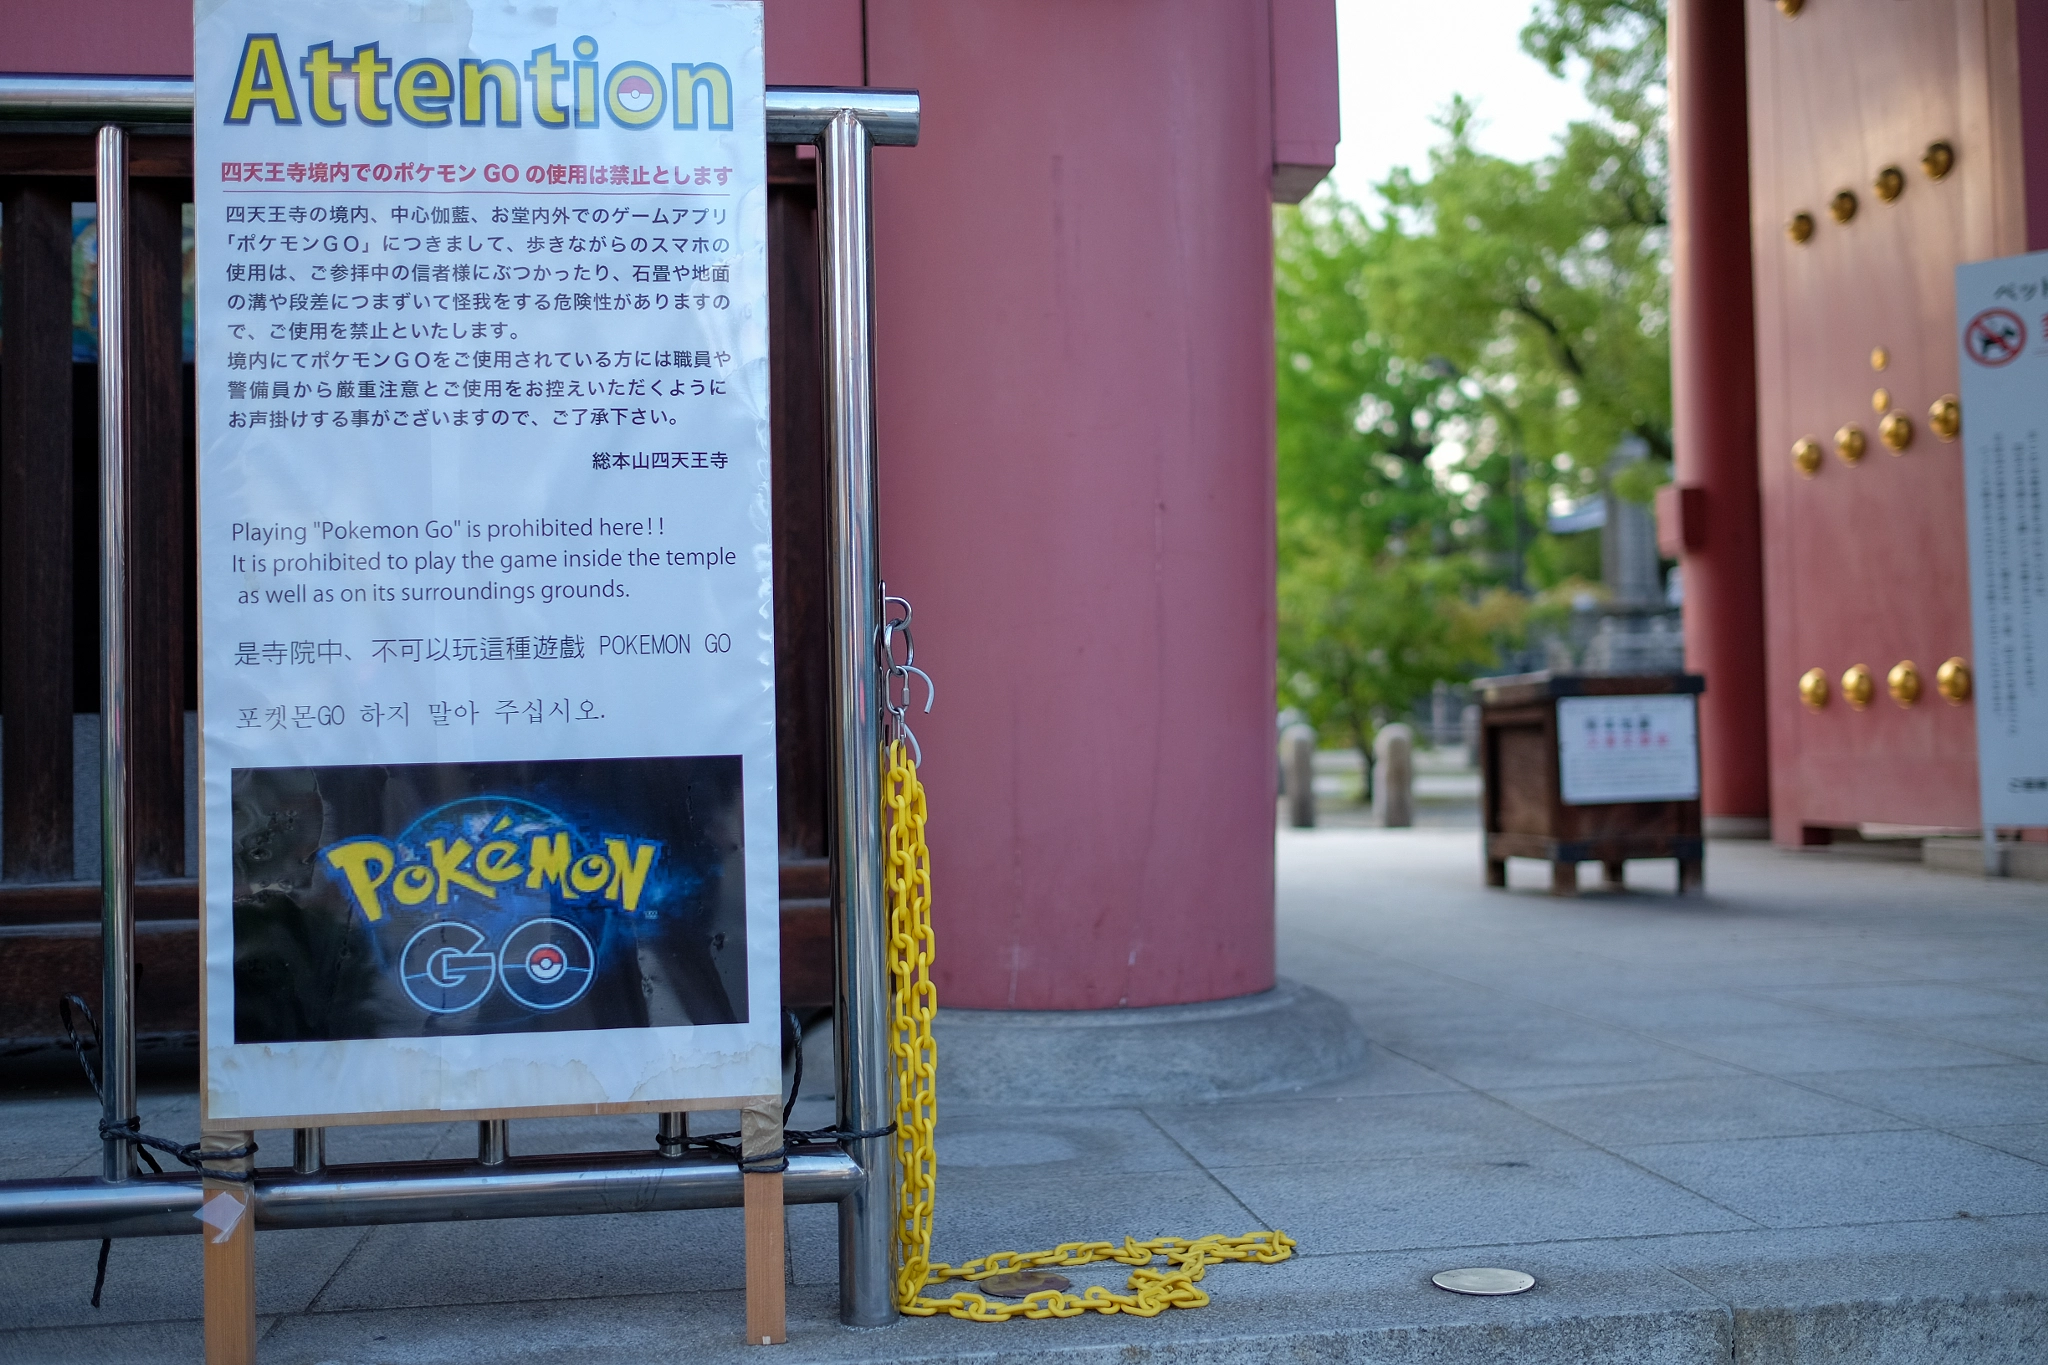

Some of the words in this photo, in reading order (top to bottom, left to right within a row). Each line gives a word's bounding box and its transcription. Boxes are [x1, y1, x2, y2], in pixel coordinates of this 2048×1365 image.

[223, 32, 734, 131] Attention
[221, 161, 477, 183] 四天王寺境内でのポケモン
[483, 164, 520, 184] GO
[525, 164, 733, 186] の使用は禁止とします
[226, 205, 727, 225] 四天王寺の境内、中心伽藍、お堂内外でのゲームアプリ
[226, 263, 730, 283] 使用は、ご参拝中の信者様にぶつかったり、石畳や地面
[227, 292, 731, 312] の溝や段差につまずいて怪我をする危険性がありますの
[227, 321, 518, 341] で、ご使用を禁止といたします。
[227, 379, 727, 400] 警備員から厳重注意とご使用をお控えいただくように
[228, 407, 677, 429] お声掛けする事がございますので、ご了承下さい。
[592, 451, 729, 470] 総本山四天王寺
[232, 522, 307, 546] Playing
[313, 520, 419, 540] "Pokemon
[425, 520, 461, 539] Go"
[466, 520, 481, 539] is
[488, 517, 593, 542] prohibited
[232, 554, 246, 572] It
[251, 554, 267, 572] is
[273, 551, 381, 577] prohibited
[387, 554, 408, 571] to
[415, 550, 456, 574] play
[461, 550, 495, 569] the
[500, 553, 558, 573] game
[563, 548, 622, 567] inside
[627, 548, 661, 567] the
[666, 546, 737, 570] temple
[238, 589, 260, 604] as
[265, 584, 307, 603] well
[313, 587, 334, 603] as
[340, 587, 367, 602] on
[372, 583, 395, 602] its
[401, 580, 535, 604] surroundings
[541, 579, 630, 603] grounds.
[234, 634, 585, 666] 是寺院中、不可以玩這種遊戲
[599, 634, 691, 655] POKEMON
[704, 633, 732, 654] GO
[235, 704, 345, 731] 포켓몬GO
[359, 701, 409, 728] 하지
[428, 700, 480, 727] 말아
[494, 698, 606, 725] 주십시오.
[399, 917, 597, 1014] GO
